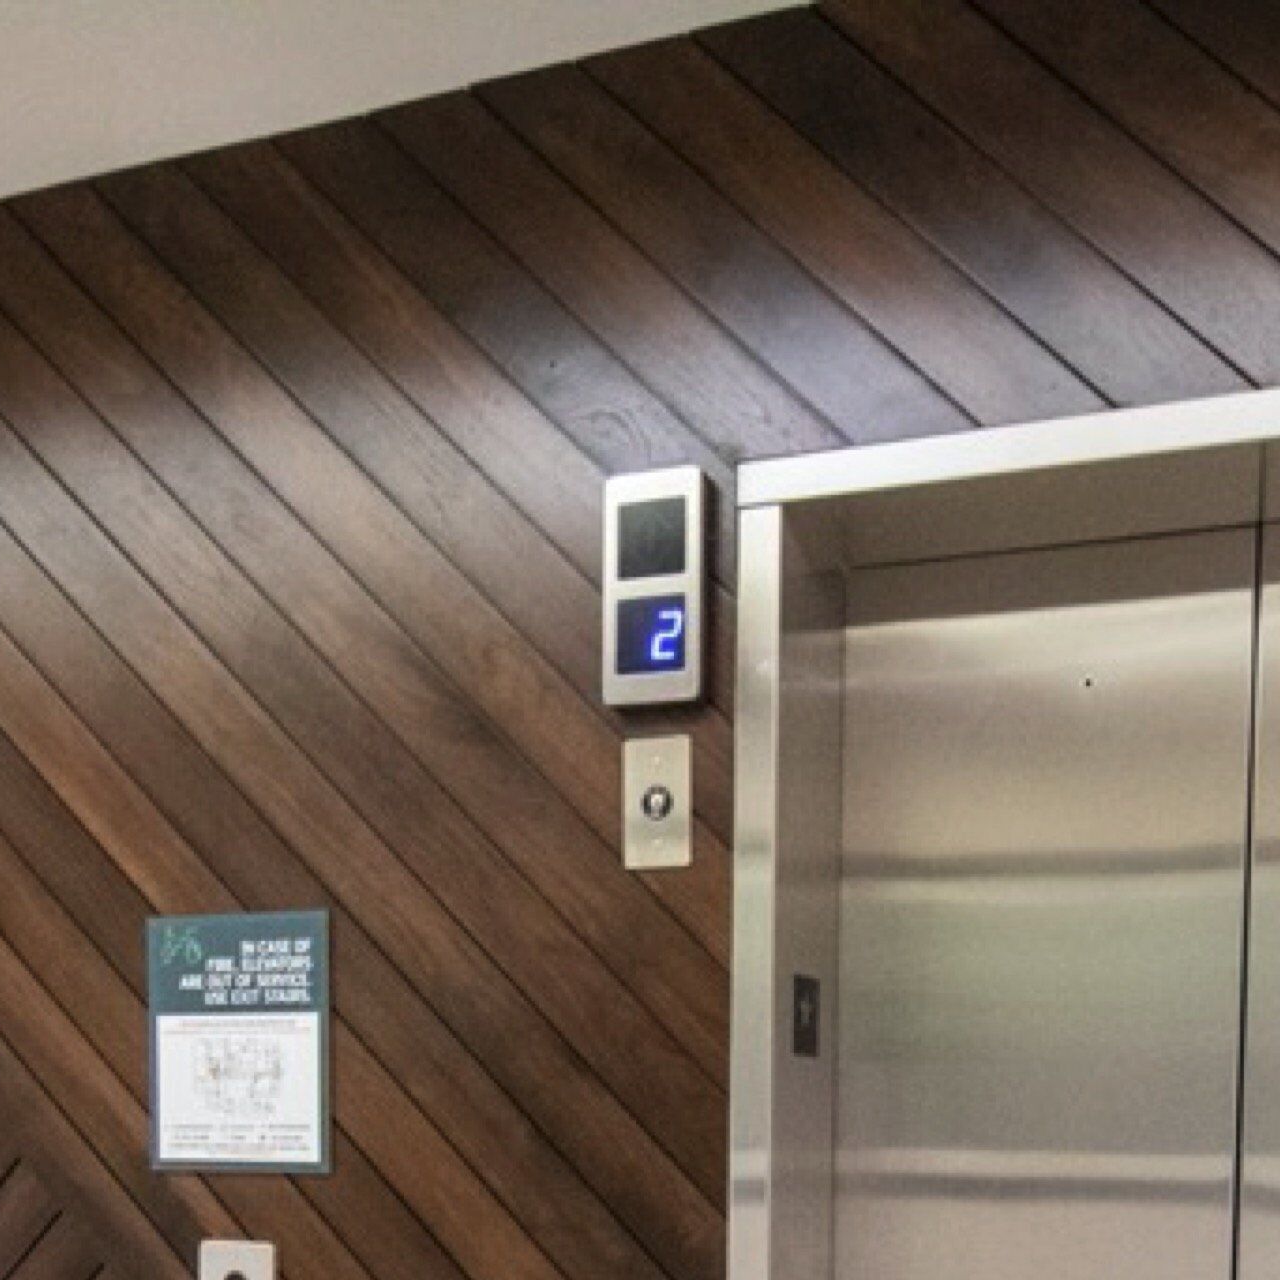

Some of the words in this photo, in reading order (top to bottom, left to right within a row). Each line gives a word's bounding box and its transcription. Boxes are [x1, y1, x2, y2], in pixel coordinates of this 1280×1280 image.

[650, 609, 683, 661] 2
[241, 940, 255, 953] IN
[257, 939, 290, 953] CASE
[294, 938, 312, 952] OF
[241, 956, 312, 971] ELEVATORS
[179, 975, 203, 990] ARE
[206, 974, 232, 988] OUT
[235, 974, 251, 988] OF
[204, 991, 228, 1005] USE
[231, 989, 260, 1005] EXIT
